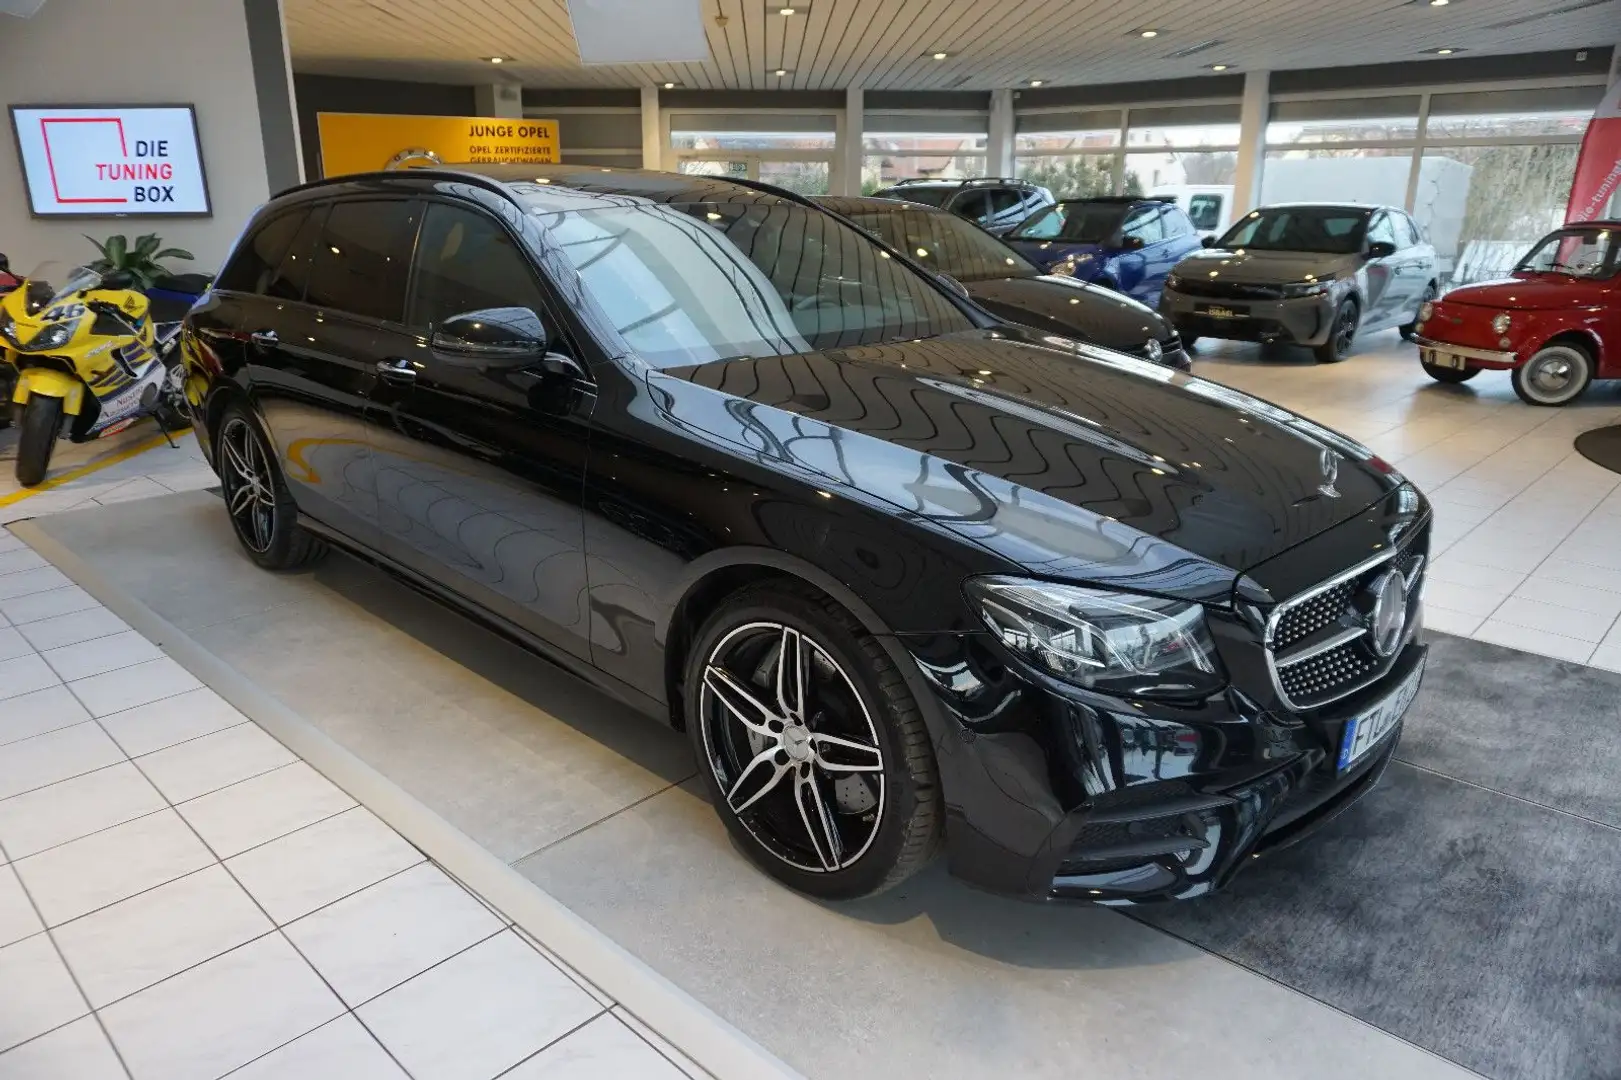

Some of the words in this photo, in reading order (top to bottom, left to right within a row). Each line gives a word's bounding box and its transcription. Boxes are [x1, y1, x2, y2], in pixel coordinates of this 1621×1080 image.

[469, 125, 513, 137] JUNGE
[518, 126, 550, 138] OPEL
[135, 140, 168, 157] DIE
[469, 146, 491, 154] OPEL
[95, 163, 173, 180] TUNING
[134, 186, 175, 202] BOX
